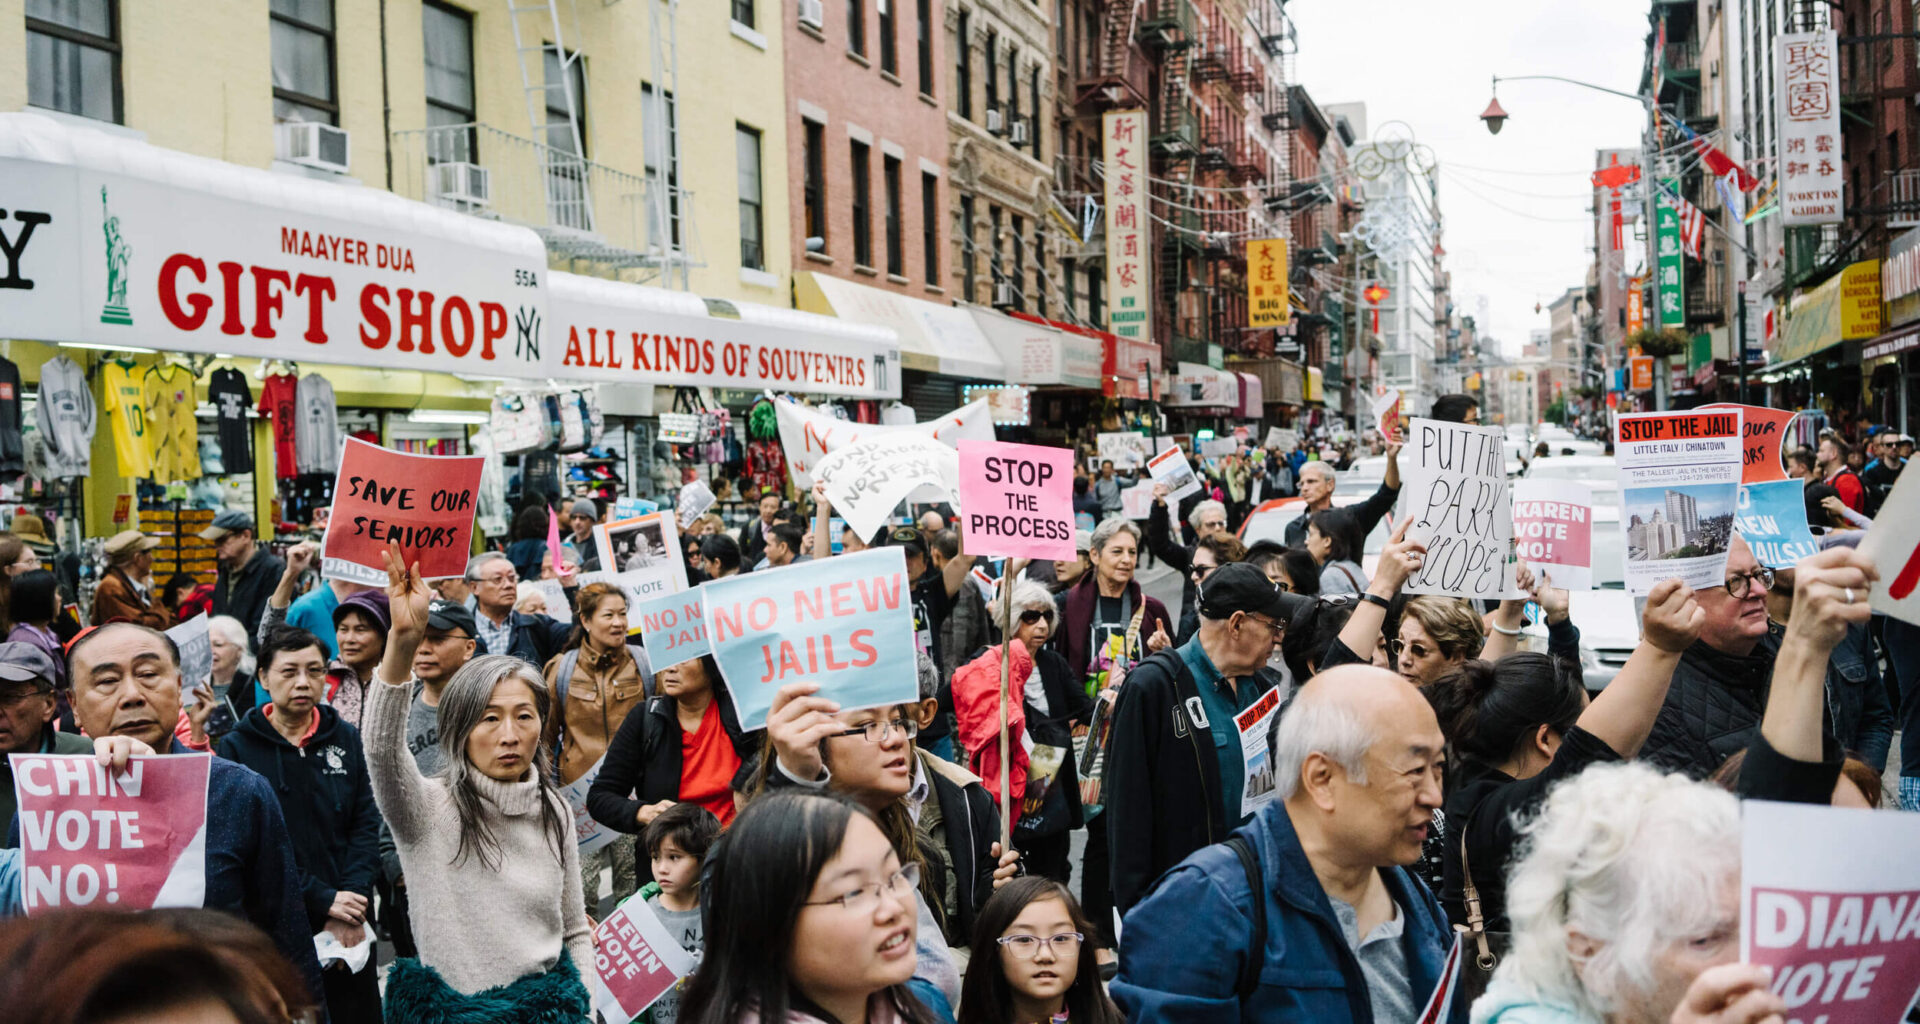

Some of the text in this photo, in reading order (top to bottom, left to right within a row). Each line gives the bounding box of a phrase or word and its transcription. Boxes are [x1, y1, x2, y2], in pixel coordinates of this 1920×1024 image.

[1788, 190, 1838, 202] WONTON
[1792, 205, 1835, 216] GARDEN
[281, 226, 415, 273] MAAYER DUA
[514, 268, 538, 288] 55A
[158, 253, 507, 360] GIFT SHOP
[1121, 297, 1135, 307] NEW
[1253, 312, 1287, 322] WONG
[1259, 299, 1278, 309] BIG
[1118, 325, 1139, 336] COURT
[563, 325, 866, 387] ALL KINDS OF SOUVENIRS
[125, 404, 144, 437] 10
[1622, 416, 1734, 440] STOP THE JAIL
[821, 444, 879, 483] FUND
[1423, 426, 1472, 473] PUT
[1633, 444, 1657, 455] LITTLE
[1660, 443, 1679, 453] ITALY
[1685, 441, 1725, 452] CHINATOWN
[843, 468, 878, 509] NOT
[868, 459, 930, 493] NEW
[985, 457, 1053, 487] STOP
[349, 476, 470, 512] SAVE OUR
[1005, 493, 1039, 512] THE
[1417, 475, 1504, 541] PARK
[971, 514, 1070, 541] PROCESS
[1515, 502, 1585, 524] KAREN
[353, 516, 457, 549] SENIORS
[1514, 522, 1567, 540] VOTE
[1518, 543, 1552, 558] NO!
[633, 580, 663, 595] VOTE
[644, 609, 677, 634] NO
[713, 573, 901, 643] NO NEW
[761, 629, 878, 683] JAILS
[1240, 711, 1255, 731] STOP
[1256, 703, 1267, 718] THE
[1267, 693, 1277, 711] JAIL
[18, 758, 143, 797] CHIN
[24, 810, 144, 851] VOTE
[27, 864, 118, 906] NO!
[597, 926, 640, 980] VOTE
[610, 911, 662, 975] LEVIN
[1766, 954, 1885, 1009] VOTE
